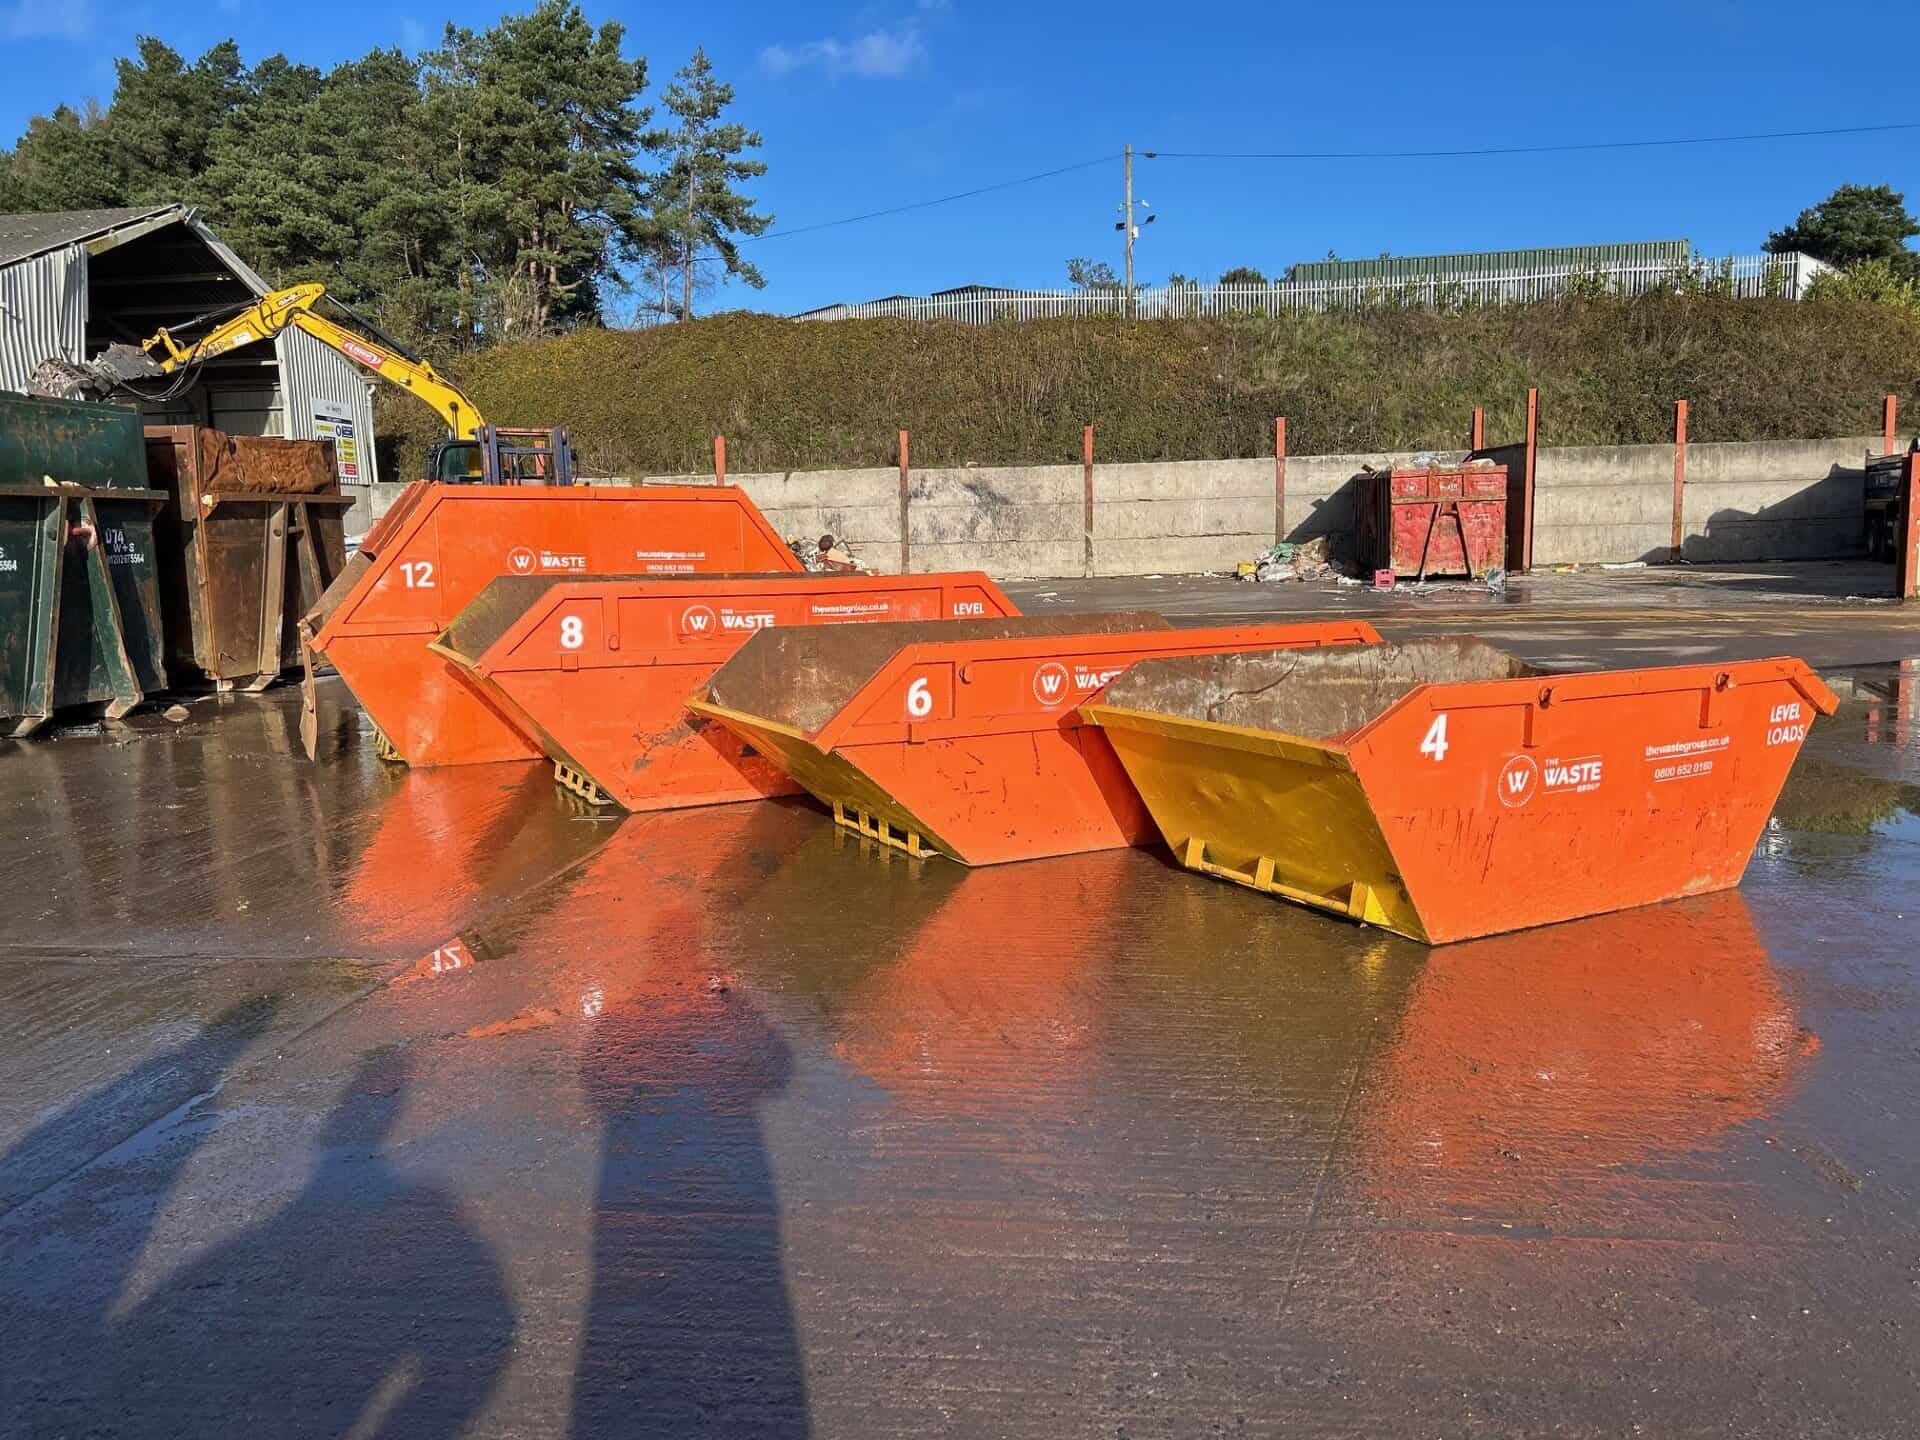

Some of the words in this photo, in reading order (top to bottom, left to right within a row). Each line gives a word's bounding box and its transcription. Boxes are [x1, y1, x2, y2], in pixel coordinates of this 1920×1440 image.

[513, 555, 530, 569] W
[540, 556, 586, 568] WASTE
[400, 562, 435, 588] 12
[953, 602, 985, 616] LEVEL
[689, 615, 709, 631] W
[720, 614, 775, 629] WASTE
[560, 616, 585, 649] 8
[1074, 665, 1088, 673] THE
[1041, 674, 1062, 694] W
[1074, 670, 1123, 689] WAS
[907, 677, 933, 717] 6
[1770, 702, 1800, 722] LEVEL
[1420, 713, 1449, 761] 4
[1767, 724, 1804, 745] LOADS
[1645, 736, 1730, 756] thewastegroup.co.uk
[1545, 758, 1560, 767] THE
[1654, 767, 1675, 779] 0800
[1676, 763, 1693, 776] 652
[1507, 769, 1530, 793] W
[1543, 761, 1603, 787] WASTE
